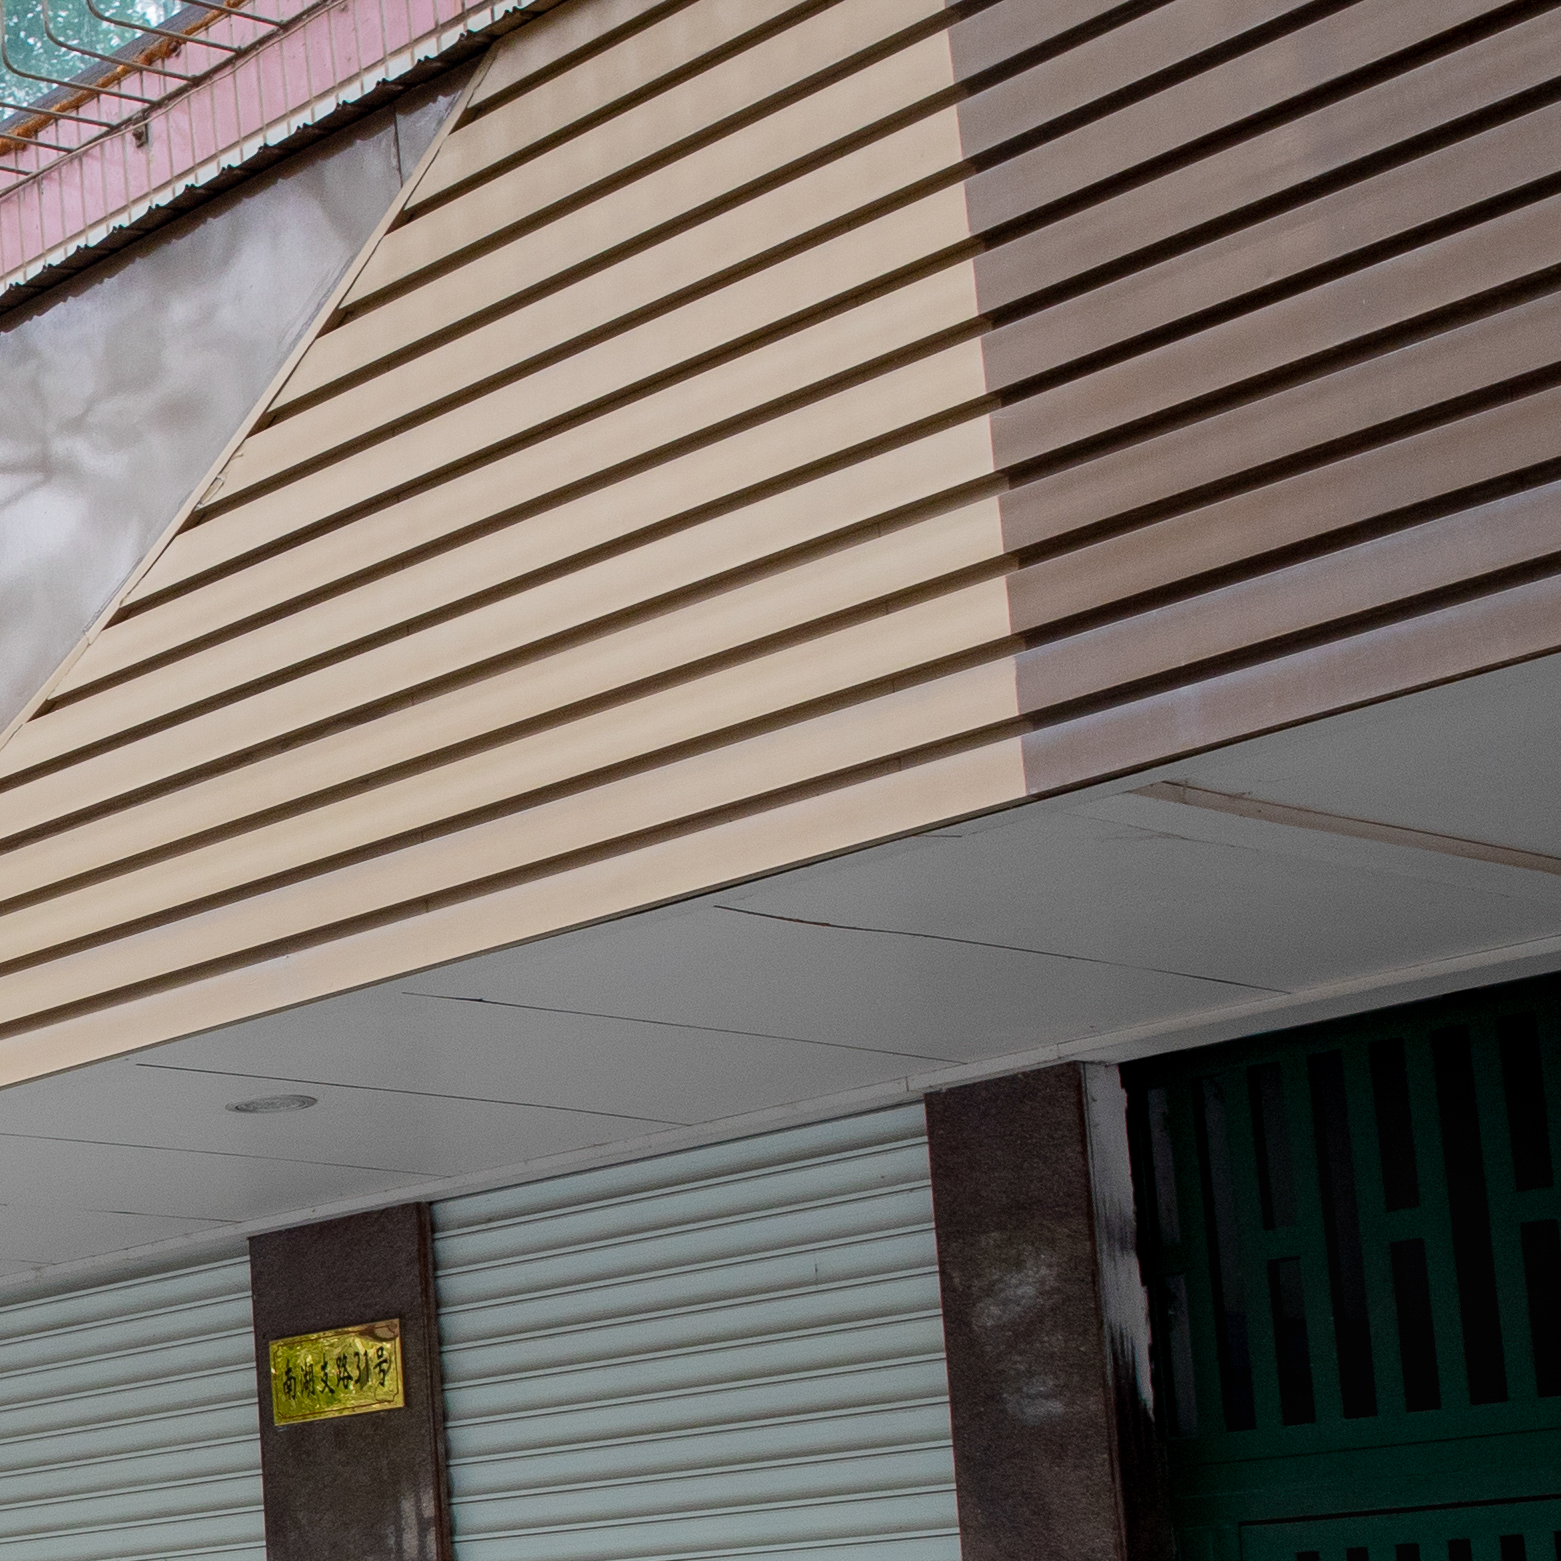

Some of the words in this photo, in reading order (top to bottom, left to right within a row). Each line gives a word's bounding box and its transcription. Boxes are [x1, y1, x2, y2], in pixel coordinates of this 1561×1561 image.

[282, 1345, 391, 1401] 南湖支路31号
